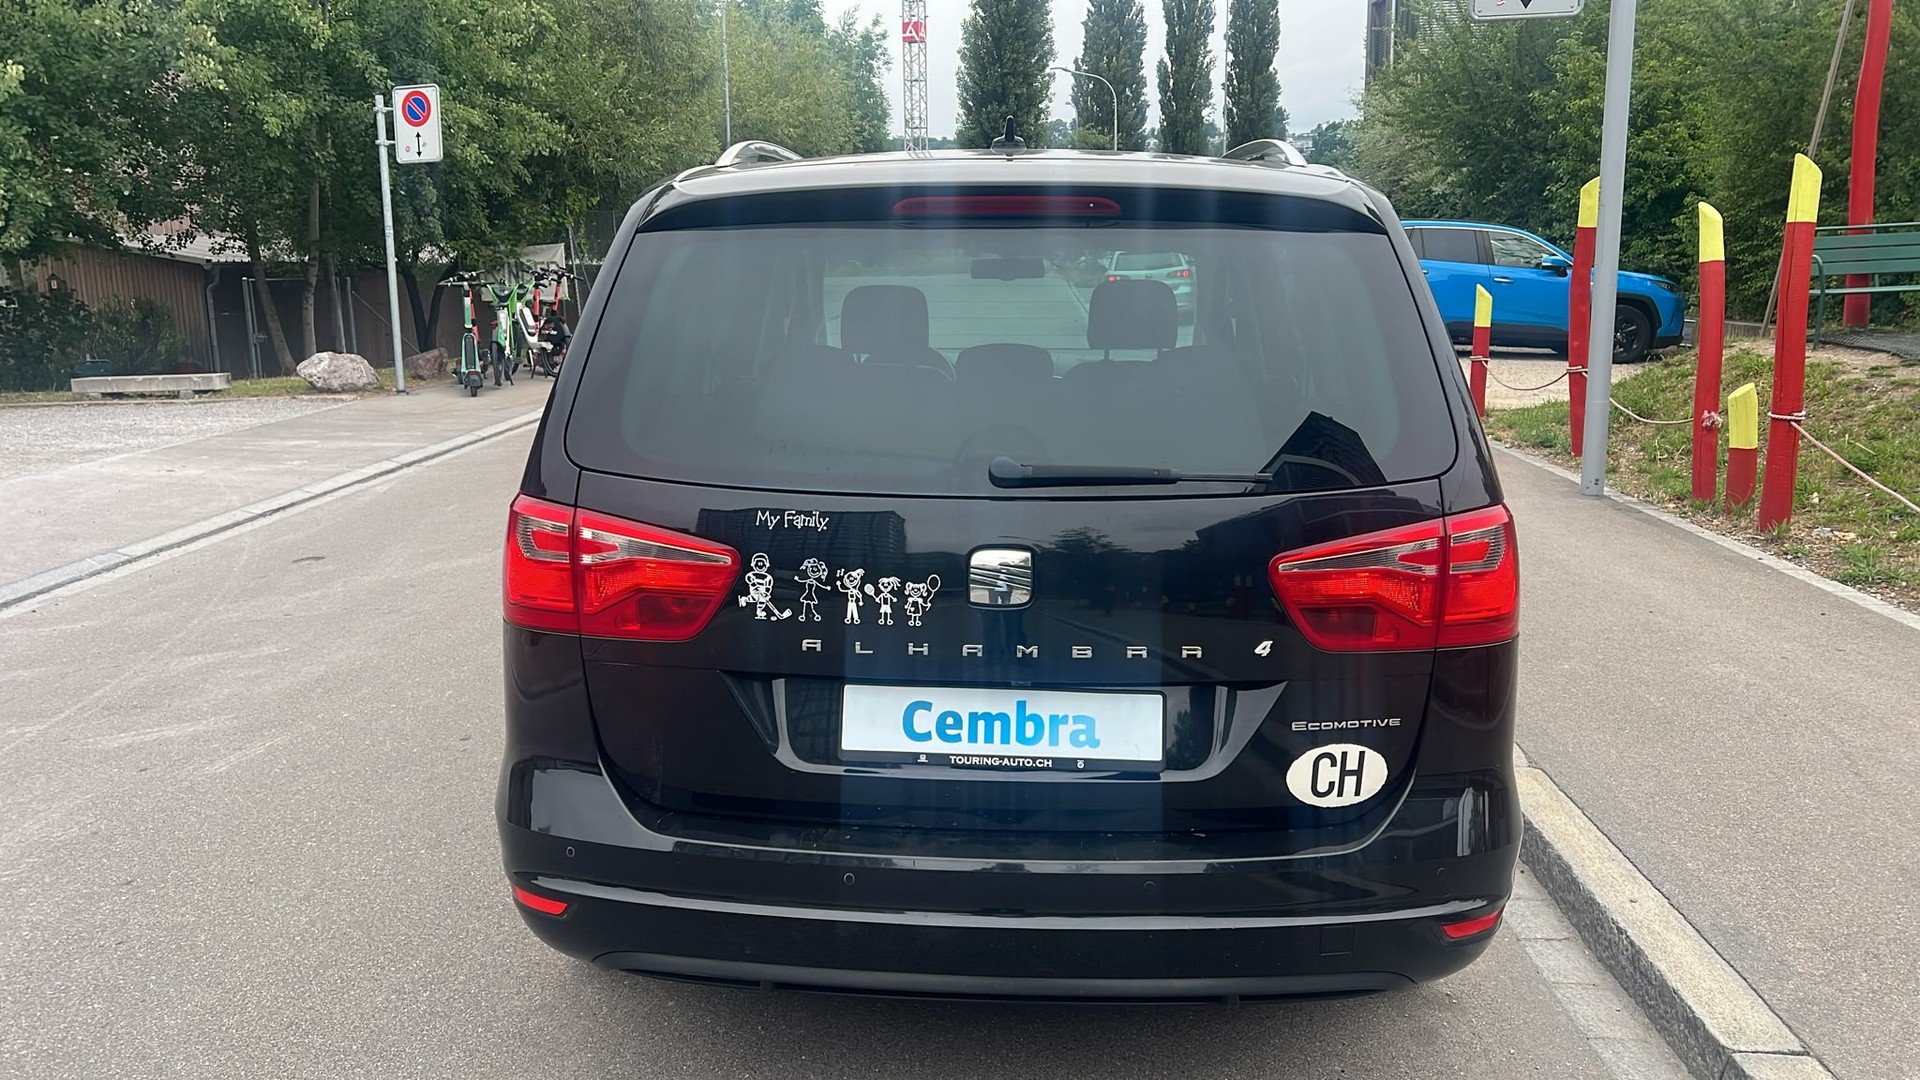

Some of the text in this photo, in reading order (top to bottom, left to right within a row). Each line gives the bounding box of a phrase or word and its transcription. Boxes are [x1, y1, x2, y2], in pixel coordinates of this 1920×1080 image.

[755, 510, 781, 531] My
[801, 638, 1274, 660] ALHAMBRA 4
[902, 699, 1101, 749] Cembra
[949, 755, 1053, 768] TOURING-AUTO.CH
[1310, 750, 1366, 799] CH
